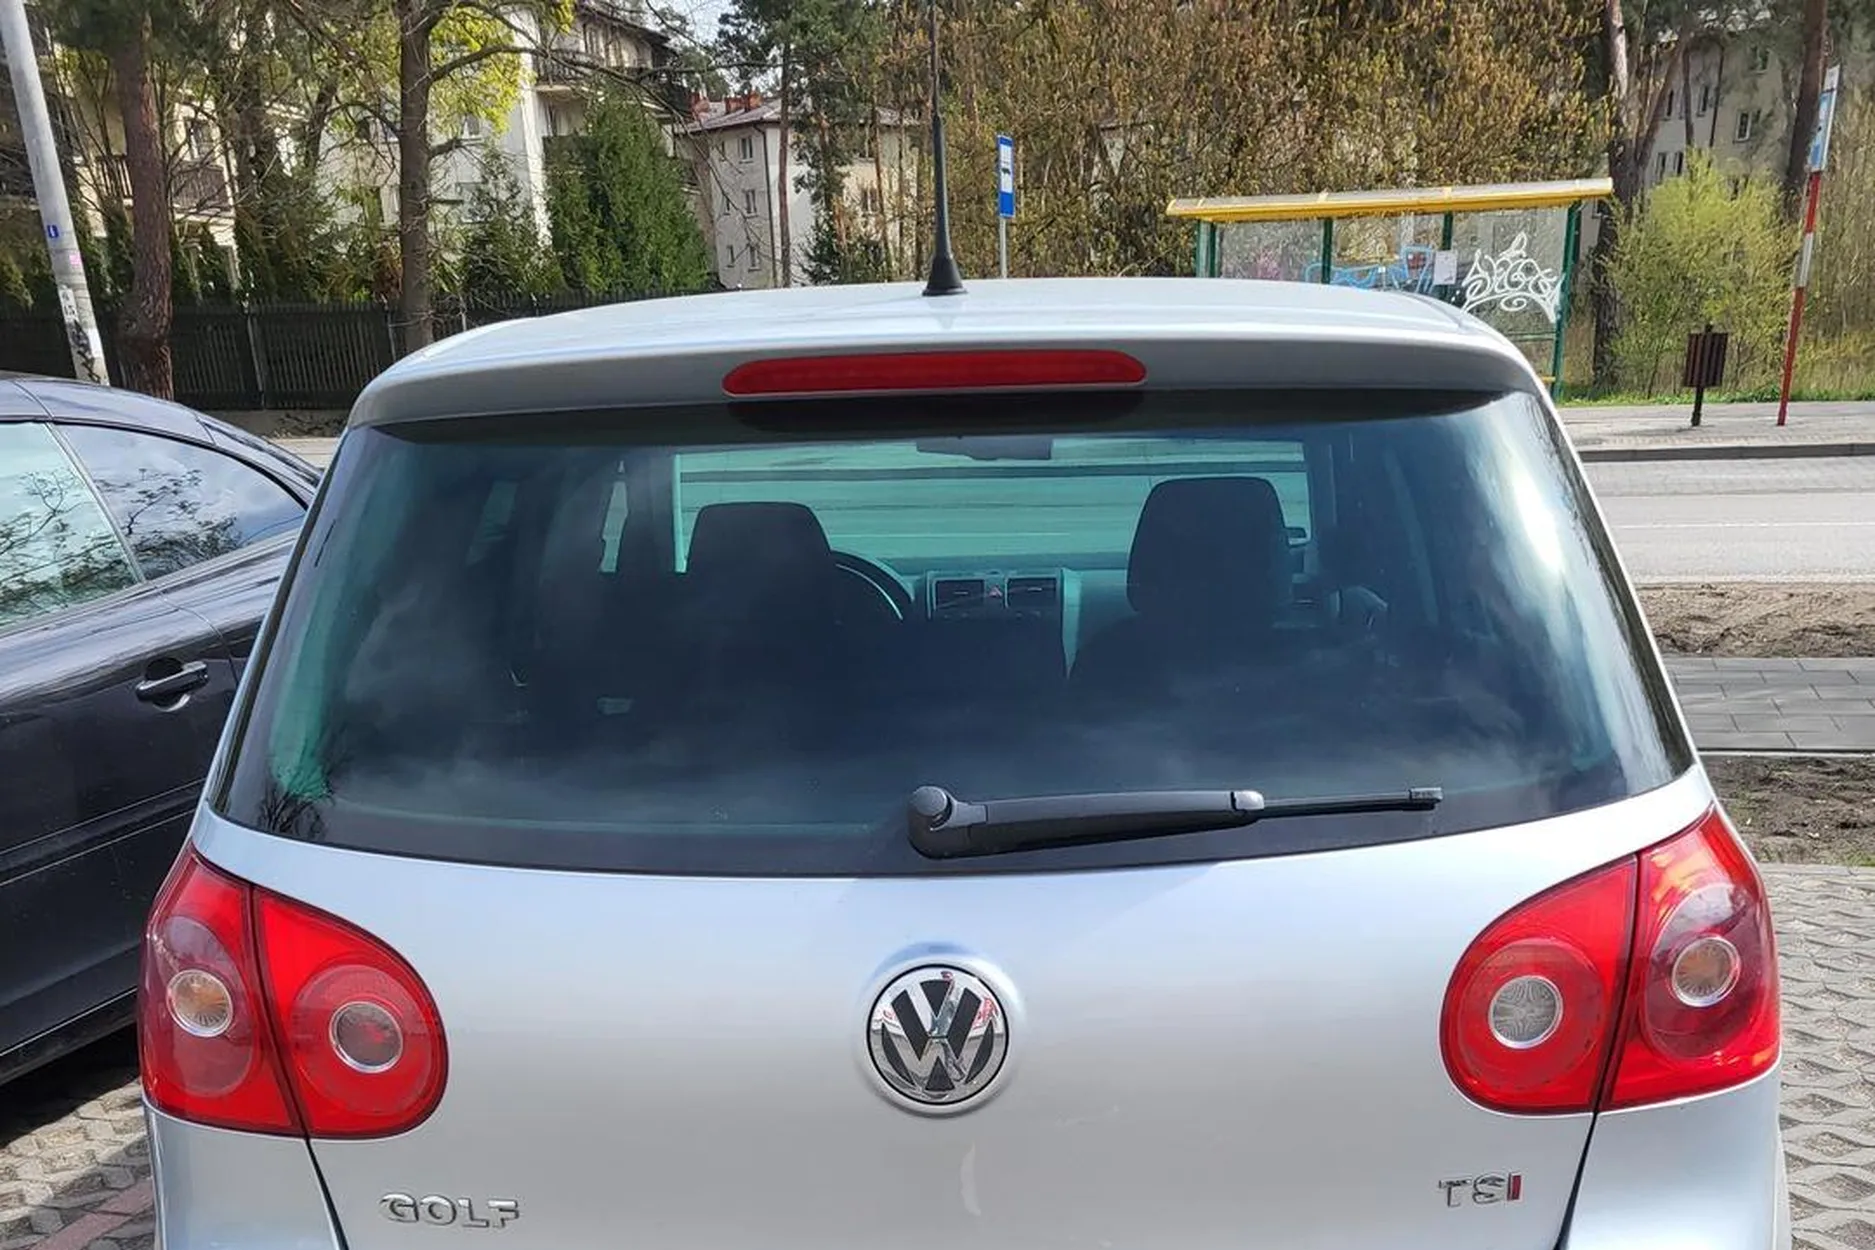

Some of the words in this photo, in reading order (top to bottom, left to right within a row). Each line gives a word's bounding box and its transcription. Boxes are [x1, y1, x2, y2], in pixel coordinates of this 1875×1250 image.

[872, 970, 1003, 1099] VW
[1438, 1173, 1522, 1207] TSI
[380, 1193, 519, 1228] GOLF
